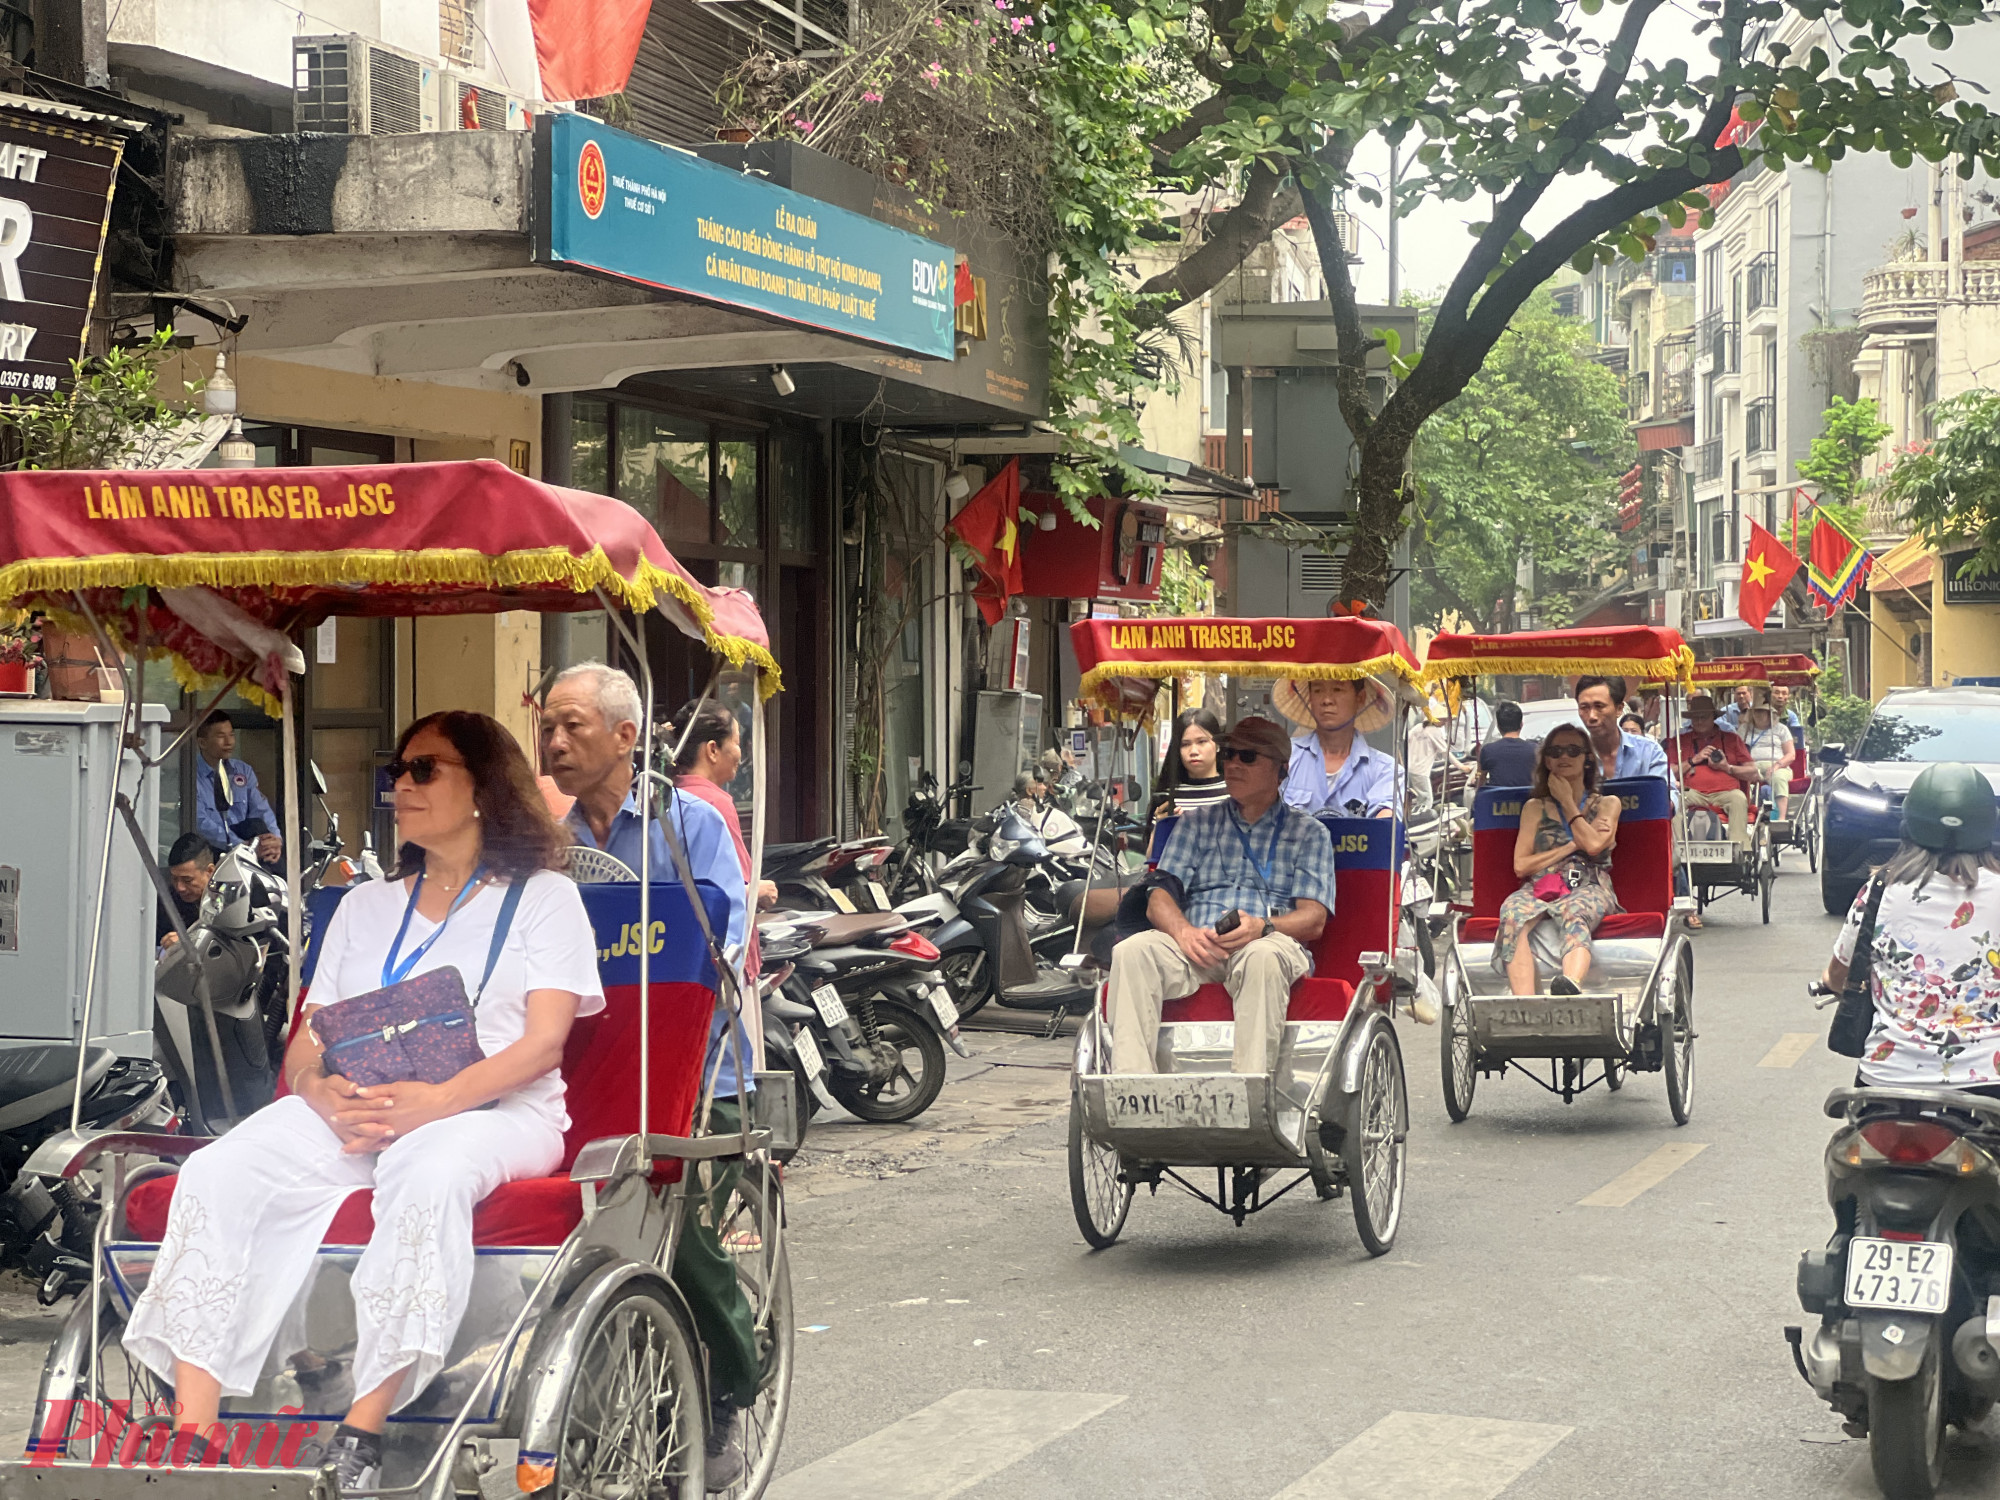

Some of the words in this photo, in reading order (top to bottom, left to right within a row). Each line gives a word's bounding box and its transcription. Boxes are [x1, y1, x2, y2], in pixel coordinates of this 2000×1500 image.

[786, 212, 796, 233] RA
[697, 216, 725, 245] THÁNG
[725, 226, 742, 250] CAO
[762, 232, 783, 262] ĐỒNG
[783, 241, 805, 269] HÀNH
[830, 256, 841, 284] HỘ
[841, 262, 858, 285] KINH
[706, 252, 717, 277] CÁ
[718, 257, 740, 284] NHÂN
[741, 265, 760, 289] KINH
[761, 270, 787, 297] DOANH
[787, 276, 807, 302] TUÂN
[822, 287, 841, 311] PHÁP
[841, 292, 858, 319] LUẬT
[858, 297, 877, 321] THUẾ
[912, 258, 938, 297] BIDV
[84, 480, 147, 520] LÂM
[153, 484, 211, 518] ANH
[1111, 625, 1147, 649] LAM
[1151, 625, 1186, 648] ANH
[1864, 1243, 1936, 1275] 29-E2
[1853, 1273, 1941, 1307] 473.76
